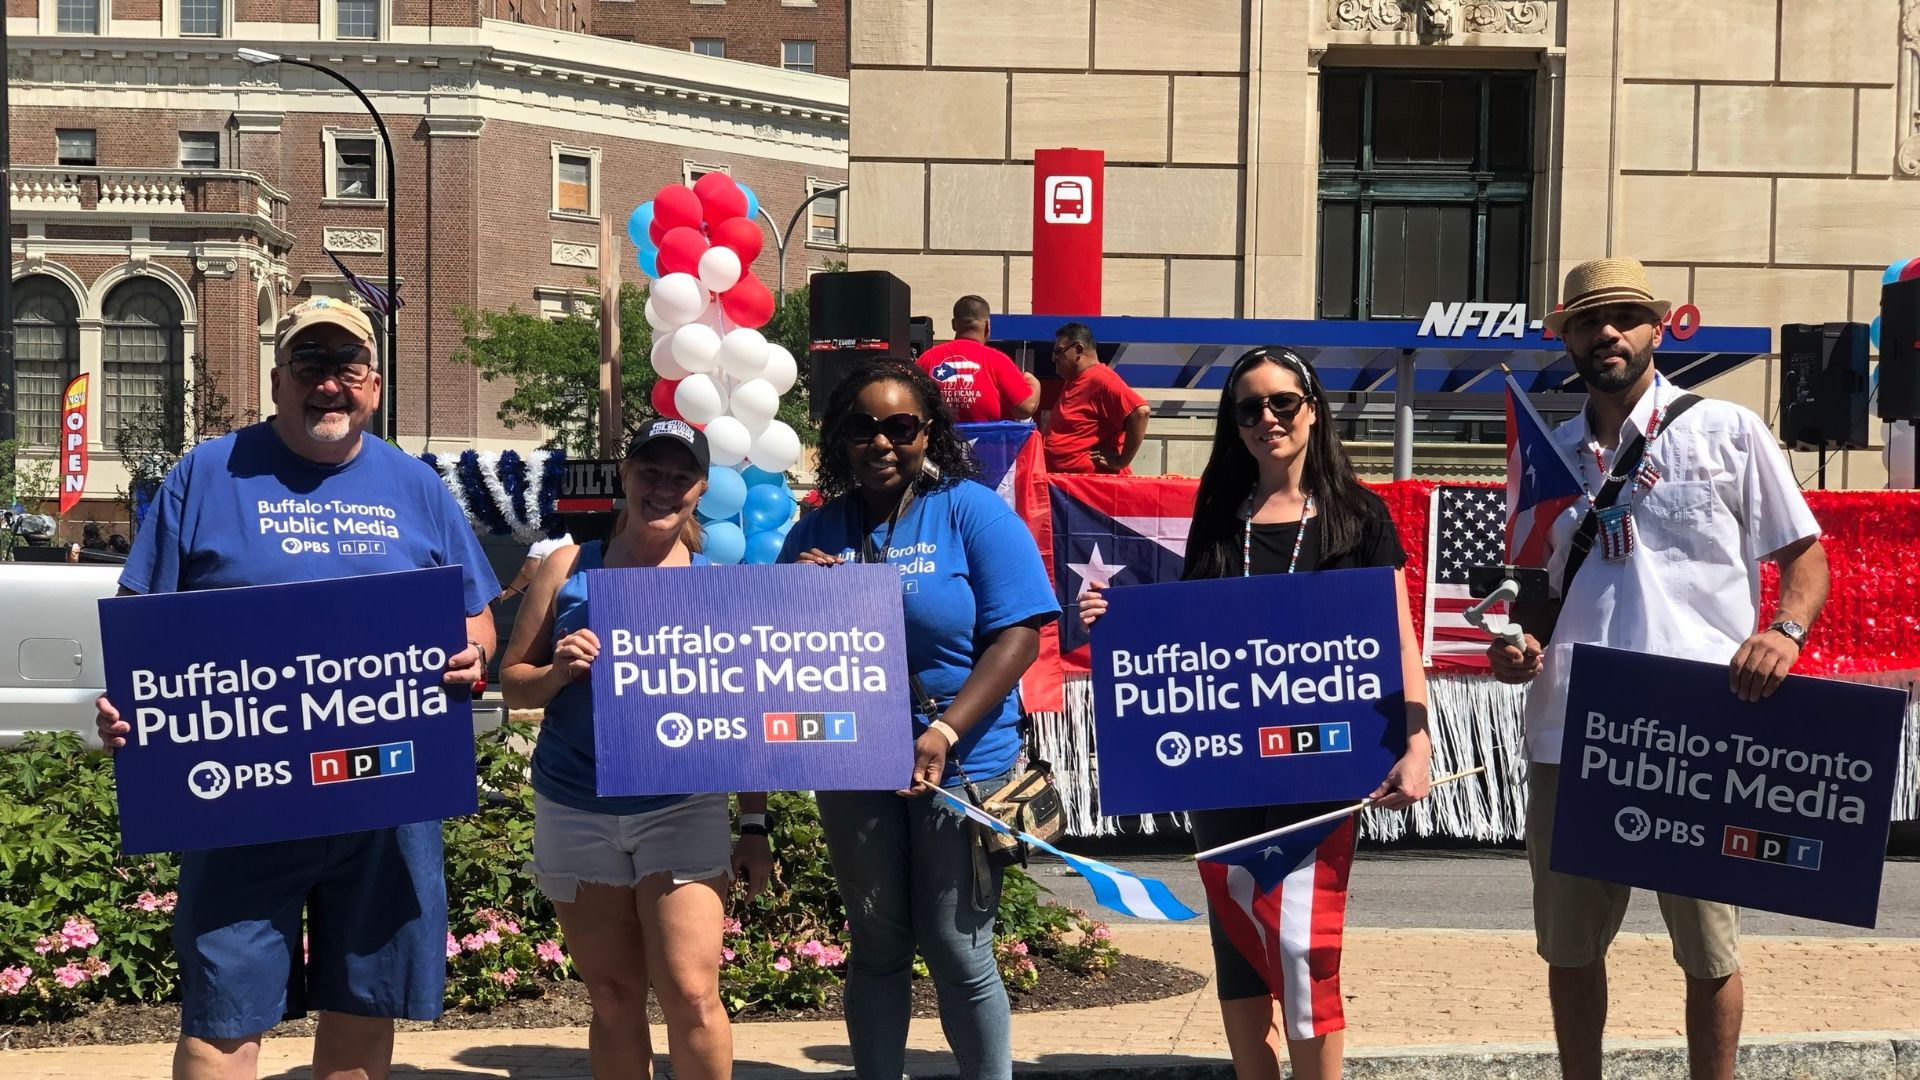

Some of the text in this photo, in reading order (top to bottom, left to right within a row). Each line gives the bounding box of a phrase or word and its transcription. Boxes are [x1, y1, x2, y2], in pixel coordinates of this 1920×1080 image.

[65, 412, 84, 493] OPEN
[561, 464, 617, 495] UILT
[259, 517, 399, 539] Public Media
[304, 541, 381, 553] PBS npr
[899, 557, 936, 576] edia
[613, 656, 887, 696] Public Media
[1114, 665, 1382, 717] Public Media
[136, 677, 447, 746] Public Media
[697, 717, 844, 740] PBS npr
[1194, 728, 1339, 758] PBS npr
[235, 747, 402, 789] PBS npr
[1580, 745, 1865, 825] Public Media
[1654, 818, 1811, 860] PBS npr
